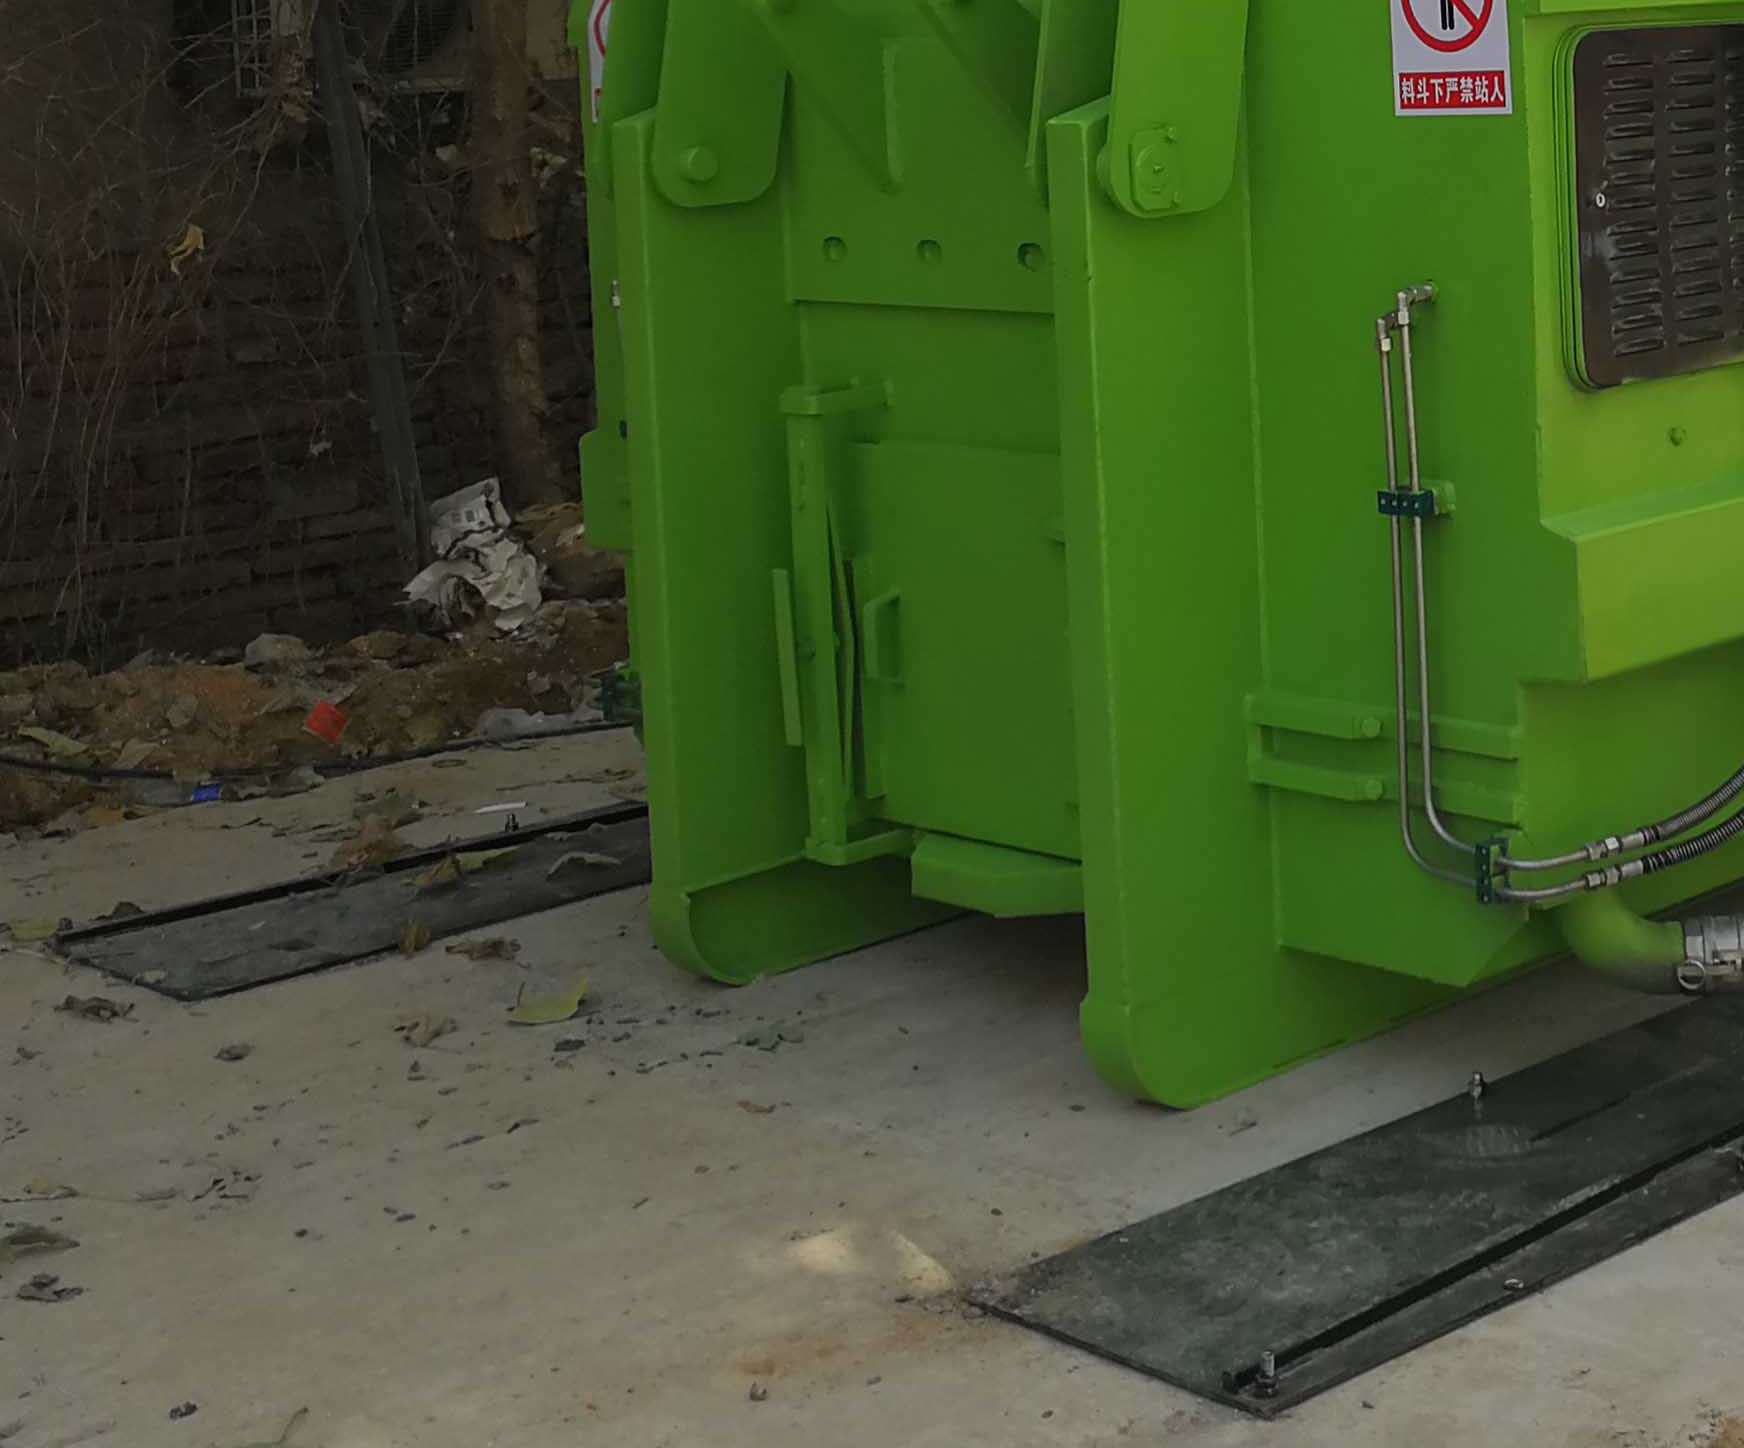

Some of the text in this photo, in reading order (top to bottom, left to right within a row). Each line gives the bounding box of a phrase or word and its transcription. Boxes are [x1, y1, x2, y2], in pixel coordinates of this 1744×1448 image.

[1401, 75, 1504, 105] 料斗下严禁站人
